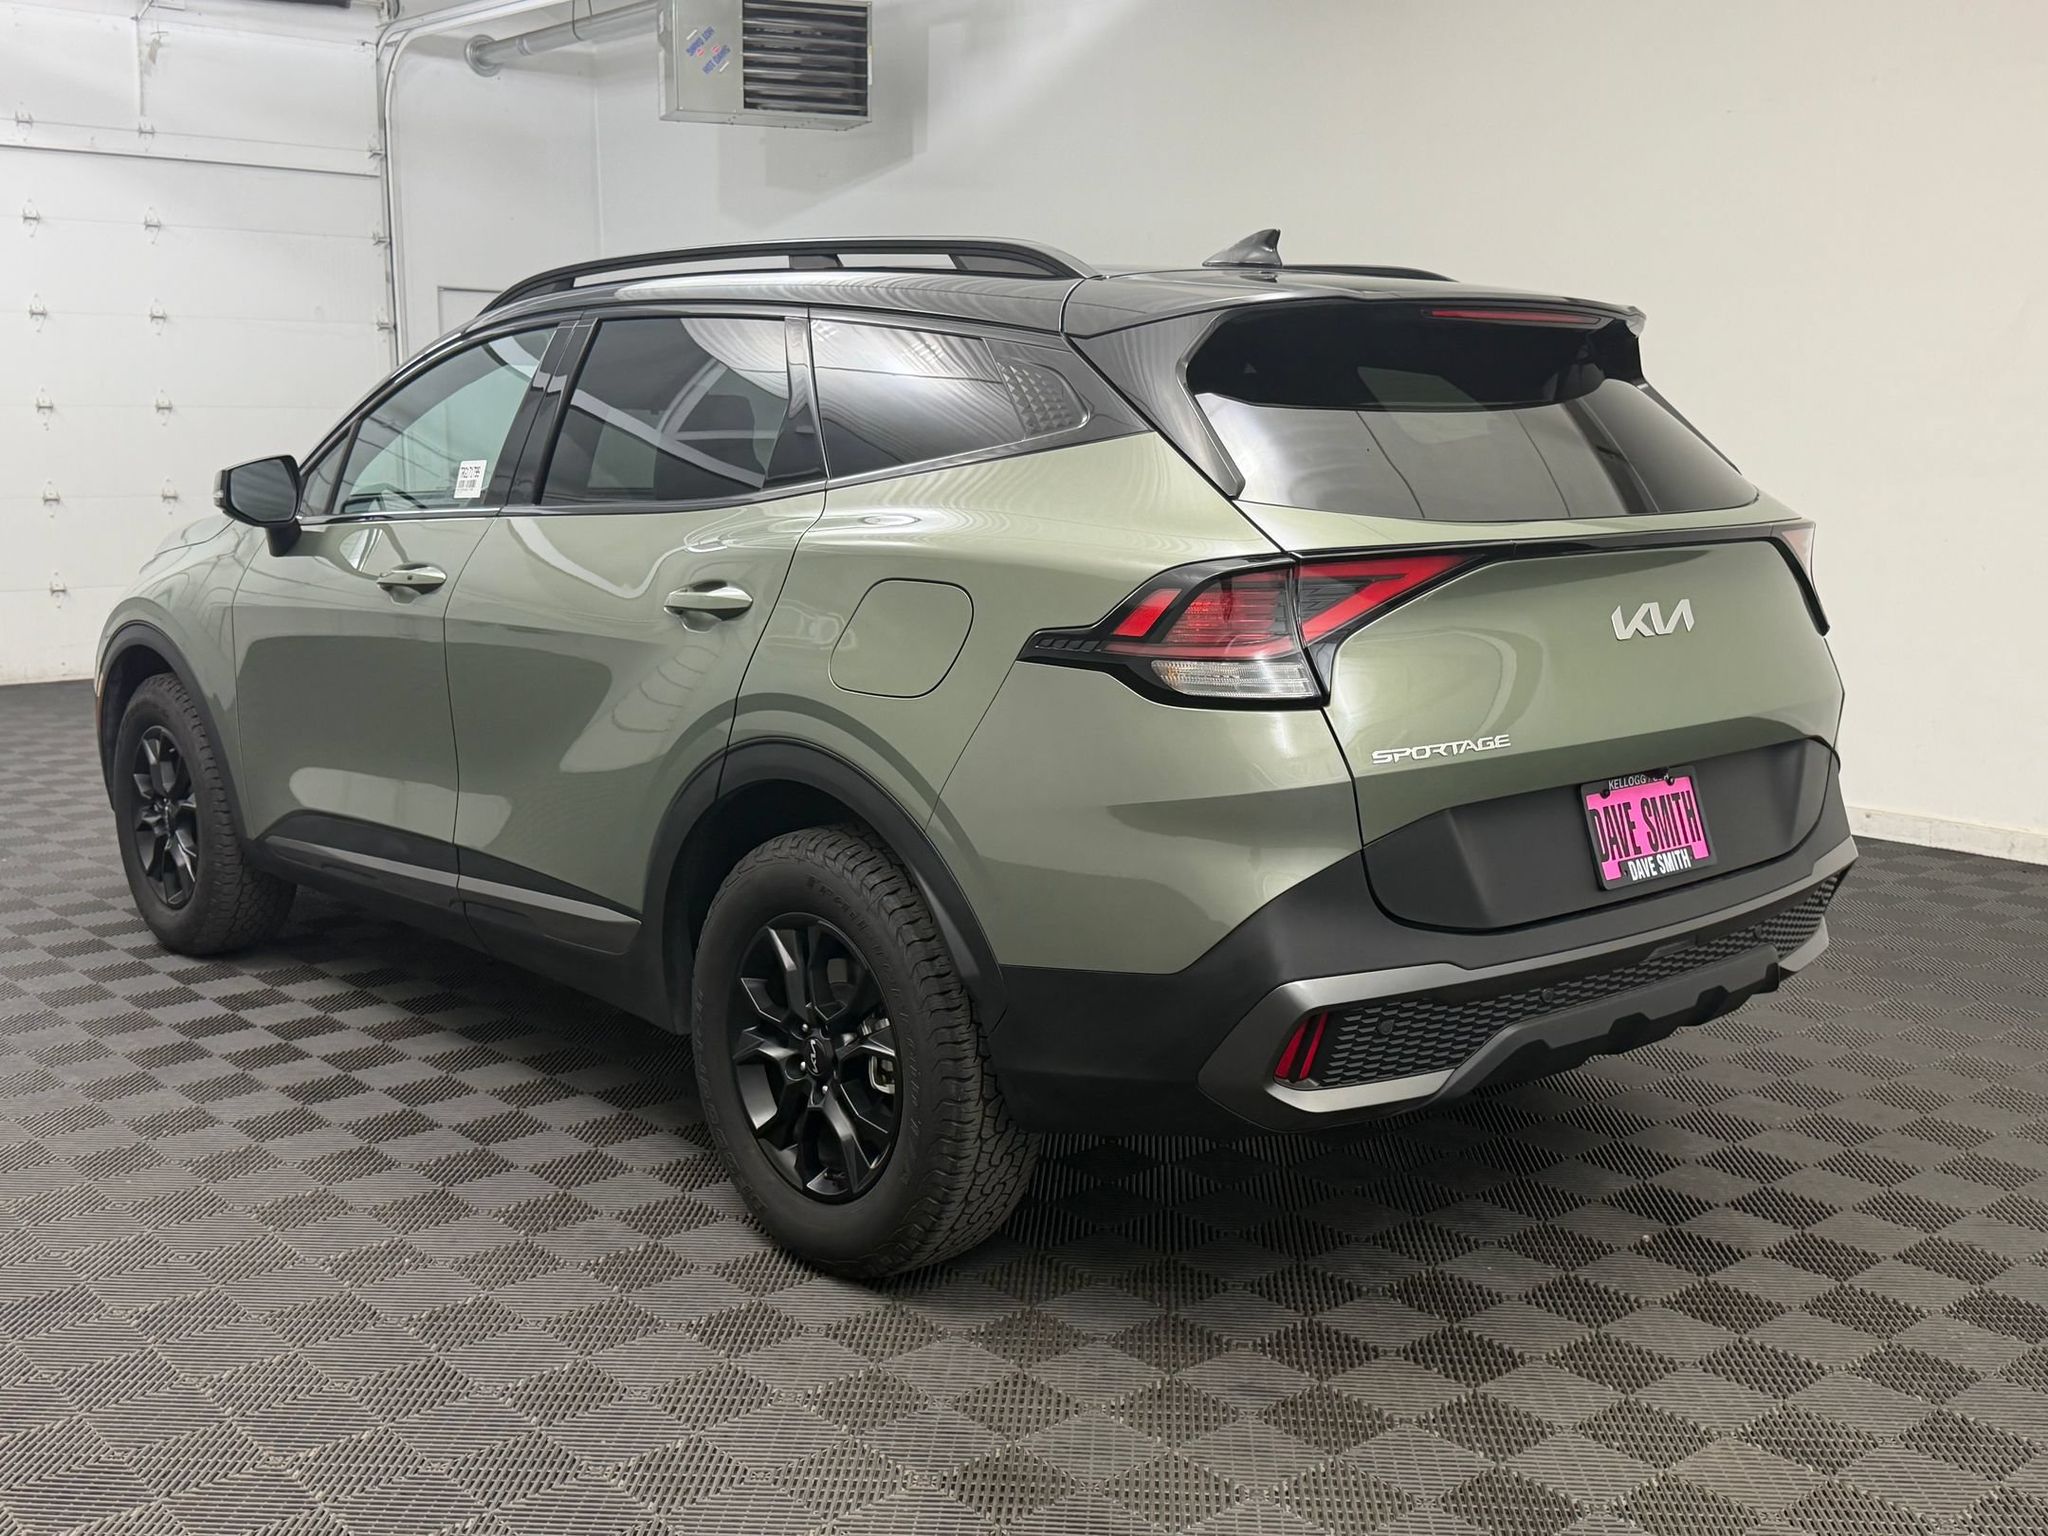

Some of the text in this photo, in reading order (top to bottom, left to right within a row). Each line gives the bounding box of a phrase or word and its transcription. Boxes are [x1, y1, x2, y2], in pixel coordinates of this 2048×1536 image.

[1611, 598, 1695, 641] KIA
[1371, 734, 1512, 764] SPORTAGE
[1608, 774, 1647, 791] KELLOGG
[1588, 790, 1702, 863] DAVE SMITH
[1627, 848, 1692, 881] DAVE SMITH
